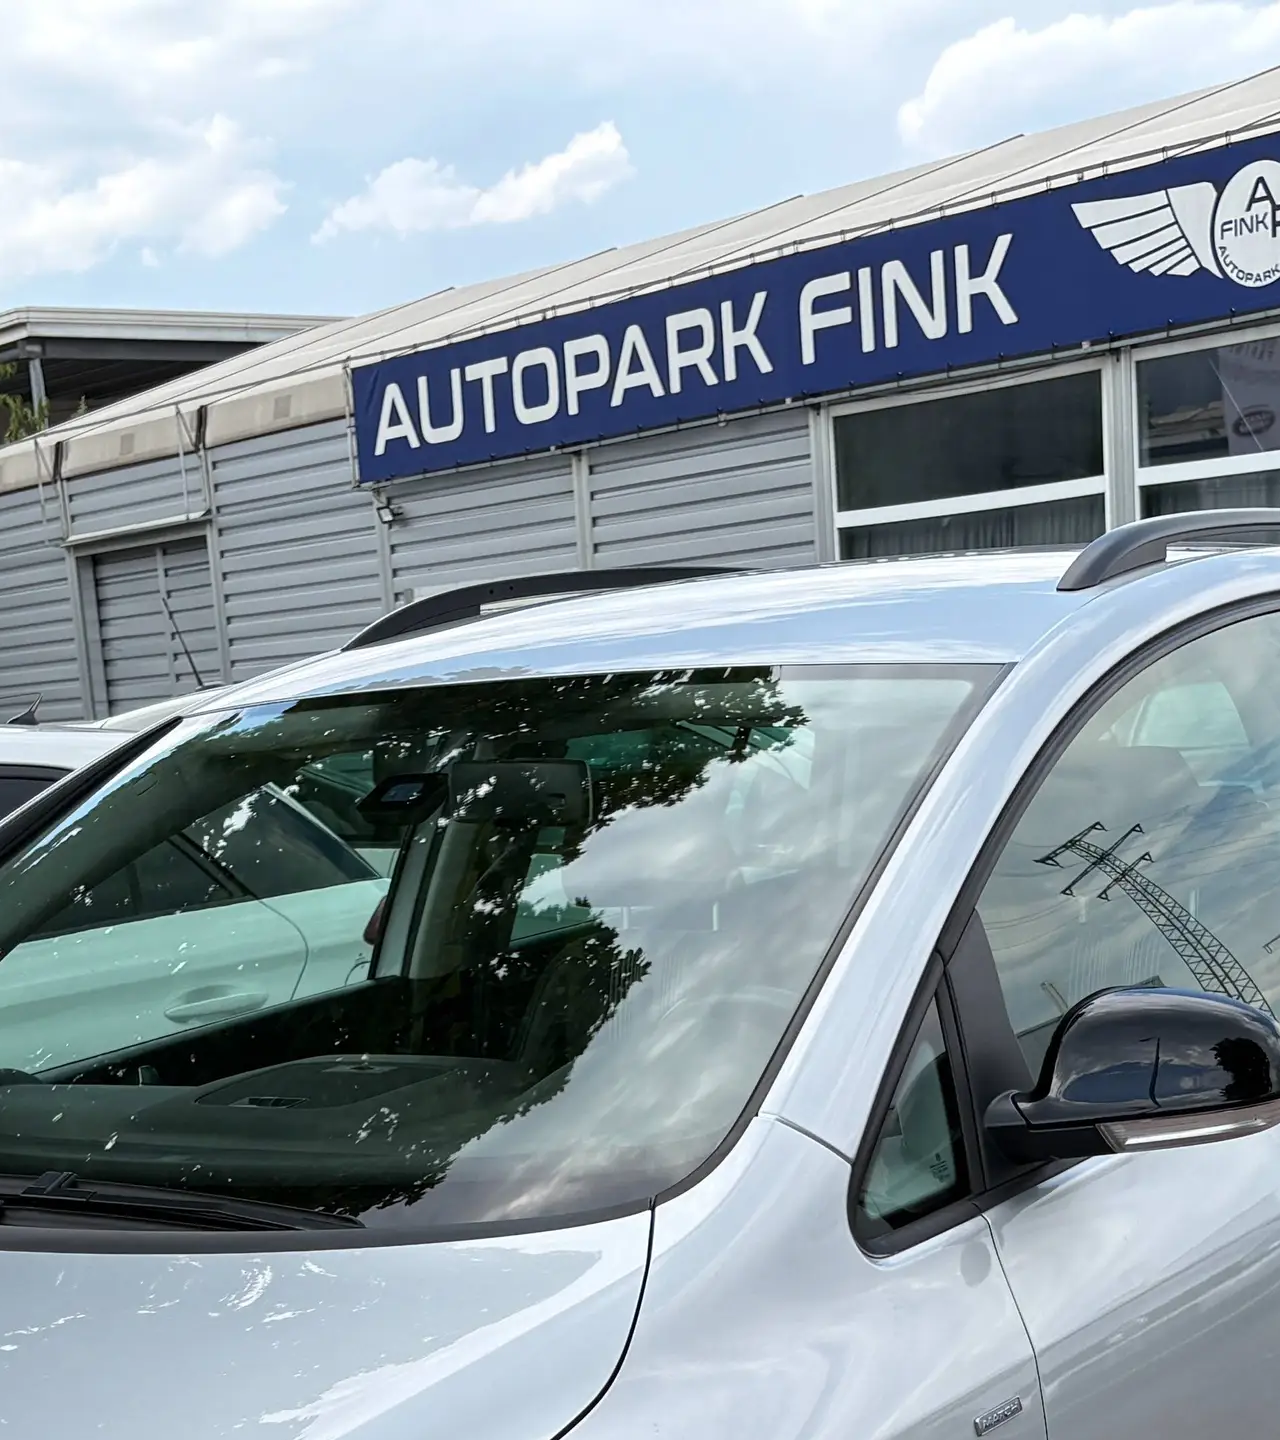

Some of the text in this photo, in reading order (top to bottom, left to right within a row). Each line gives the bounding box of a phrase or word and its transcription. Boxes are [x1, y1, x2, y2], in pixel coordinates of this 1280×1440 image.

[1220, 211, 1269, 240] FINK
[1219, 245, 1280, 284] AUTOPARK
[373, 232, 1019, 457] AUTOPARK FINK
